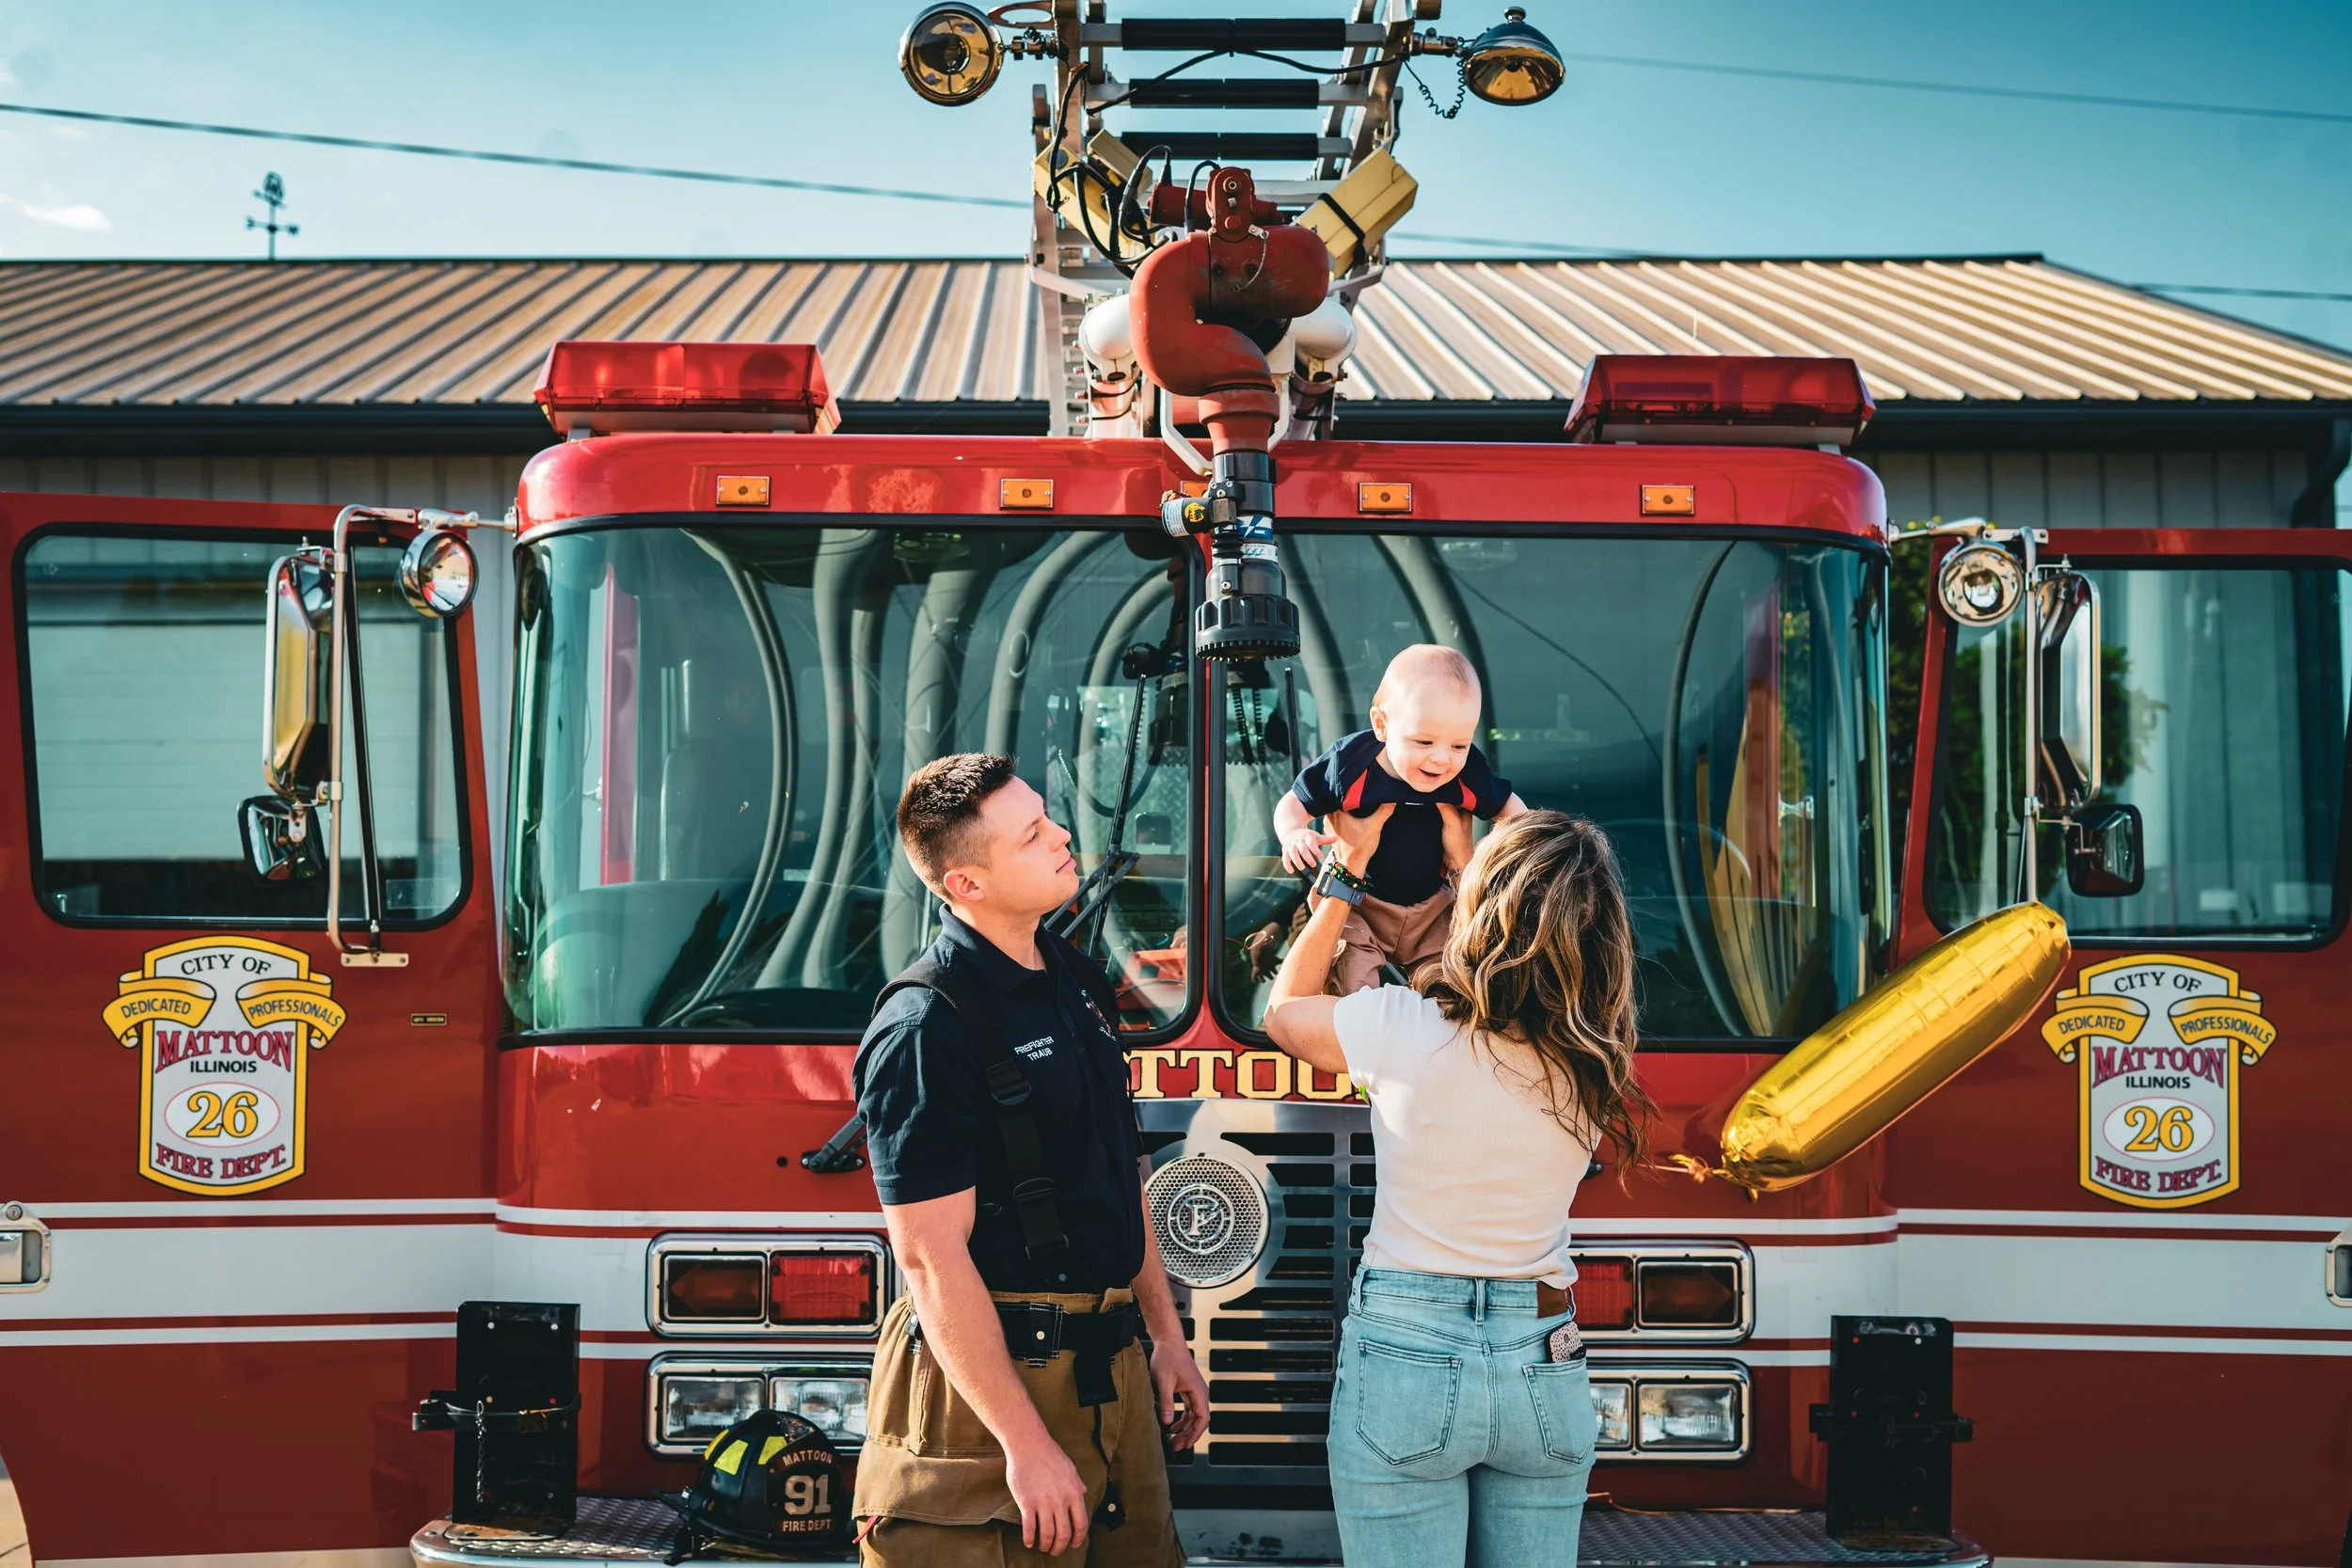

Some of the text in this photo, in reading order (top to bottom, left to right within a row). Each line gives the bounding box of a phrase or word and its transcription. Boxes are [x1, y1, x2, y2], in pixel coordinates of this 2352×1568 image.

[181, 954, 271, 975] CITY OF
[2114, 972, 2201, 992] CITY OF
[120, 998, 342, 1028] DEDICATED PROFESSIONALS
[2058, 1015, 2272, 1044] DEDICATED PROFESSIONALS
[155, 1031, 294, 1074] MATTOON
[1014, 1036, 1055, 1055] FIREFIGHTER
[1026, 1047, 1053, 1061] TRAUB
[190, 1060, 257, 1073] ILLINOIS
[2092, 1046, 2226, 1088] MATTOON
[2125, 1076, 2191, 1089] ILLINOIS
[186, 1090, 259, 1138] 26
[2124, 1105, 2194, 1152] 26
[155, 1142, 213, 1179] FIRE
[2094, 1155, 2152, 1192] FIRE
[782, 1449, 833, 1466] MATTOON
[784, 1474, 832, 1515] 91
[783, 1518, 832, 1532] FIRE DEPT
